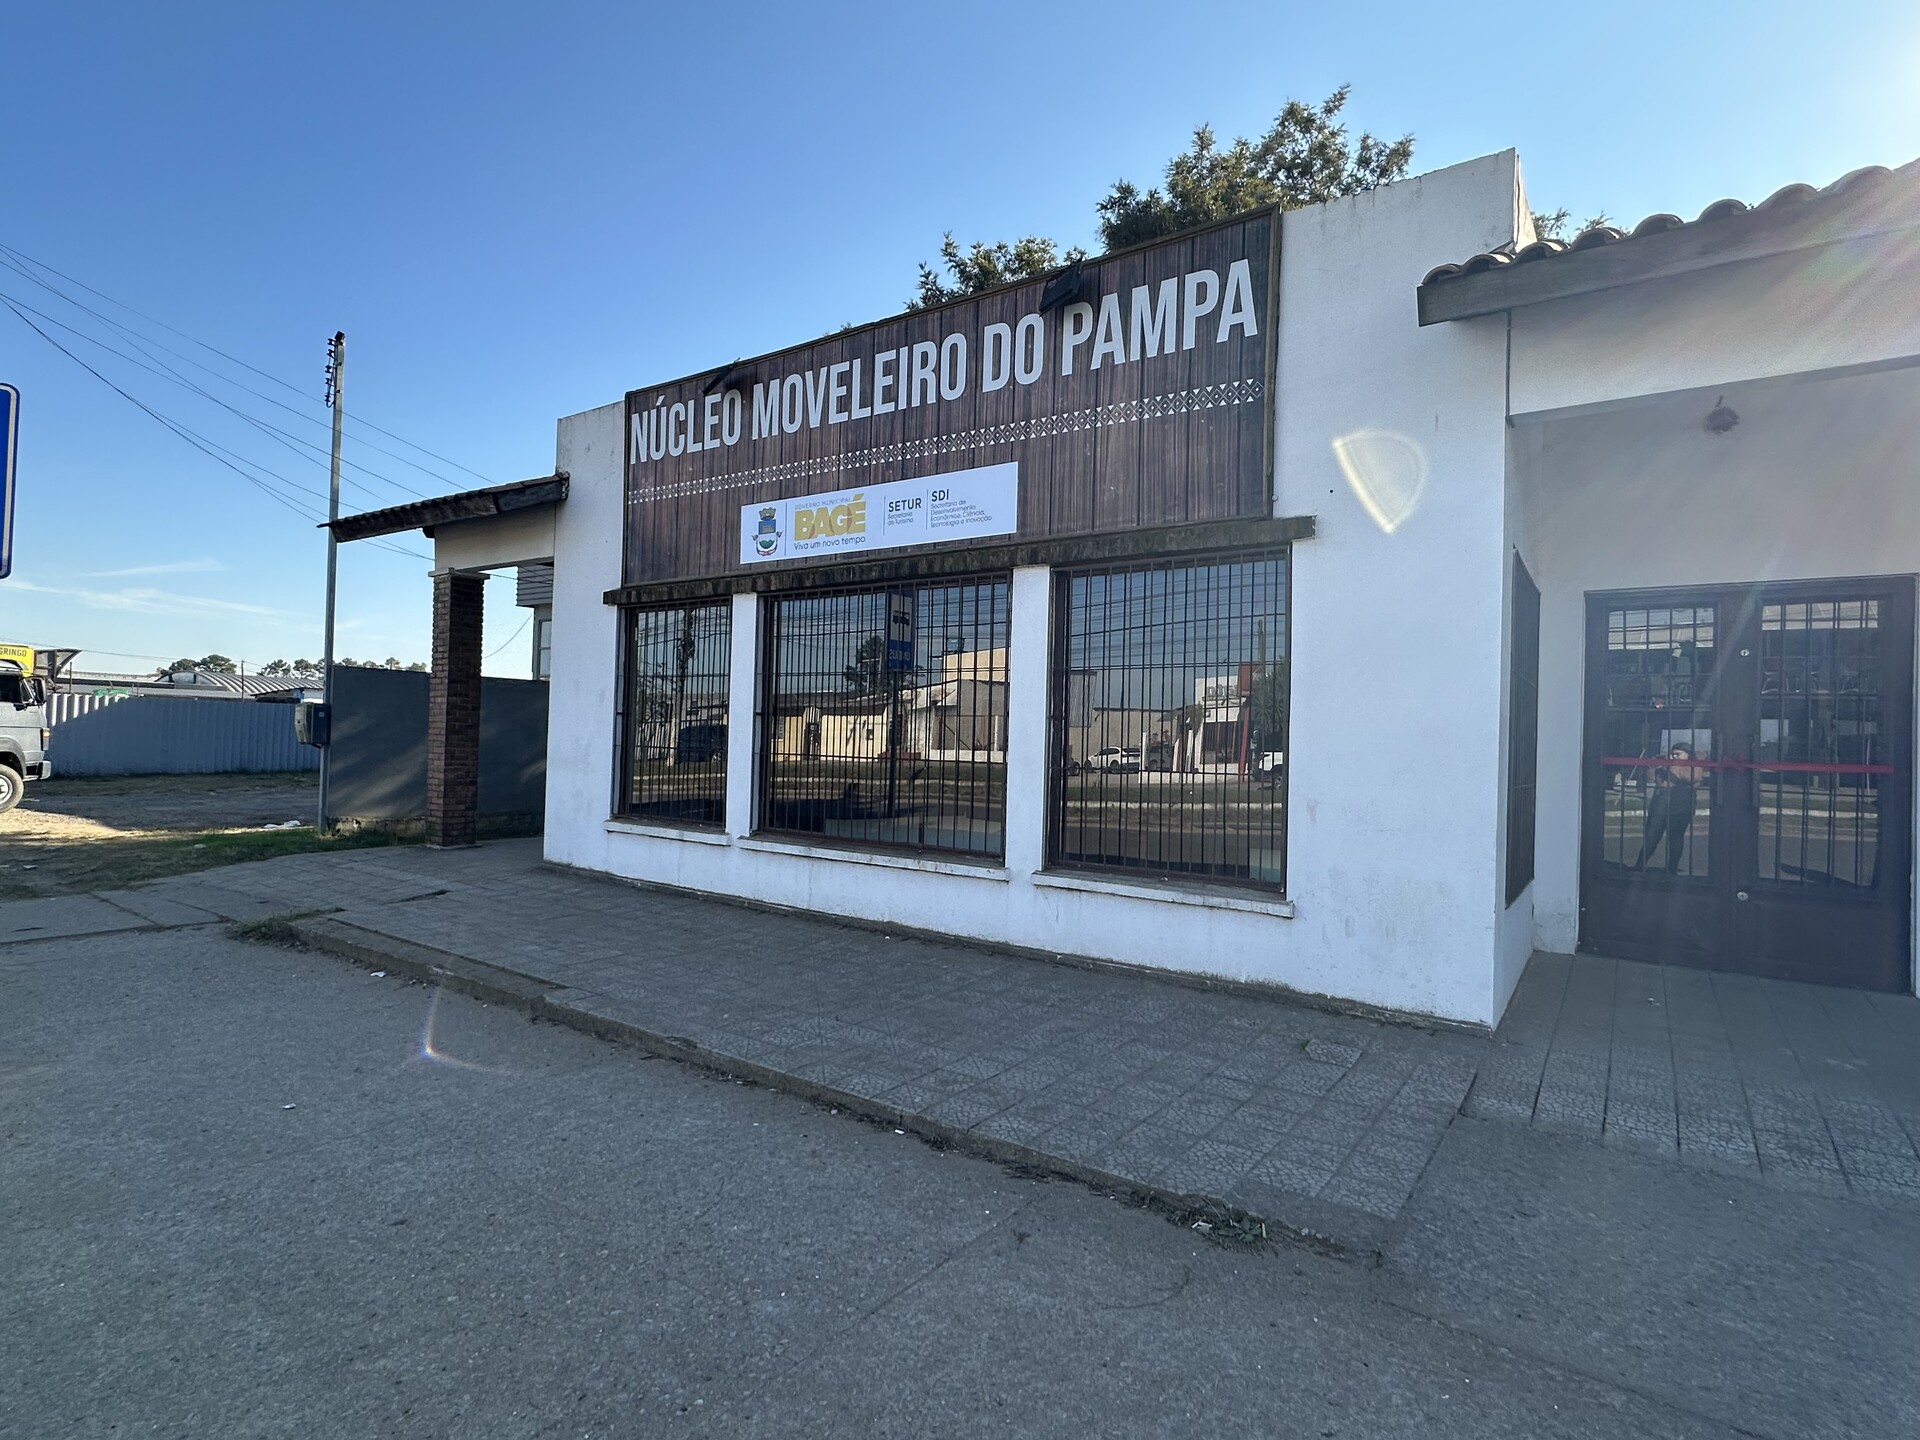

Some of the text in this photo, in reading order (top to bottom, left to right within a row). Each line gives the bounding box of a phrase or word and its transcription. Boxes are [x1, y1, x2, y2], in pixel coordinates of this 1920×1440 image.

[630, 258, 1258, 465] NÚCLEO MOVELEIRO DO PAMPA
[931, 488, 950, 502] SDI
[794, 497, 851, 510] GOVERNO MUNICIPAL
[888, 498, 922, 513] SETUR
[930, 501, 957, 509] Secretaria
[930, 505, 976, 515] Desenvolvimento
[795, 493, 866, 541] BAGÉ
[930, 519, 960, 528] Tecnologia
[966, 515, 993, 523] Inovação
[794, 542, 809, 550] Viva
[822, 539, 840, 547] novo
[841, 536, 866, 545] tempo
